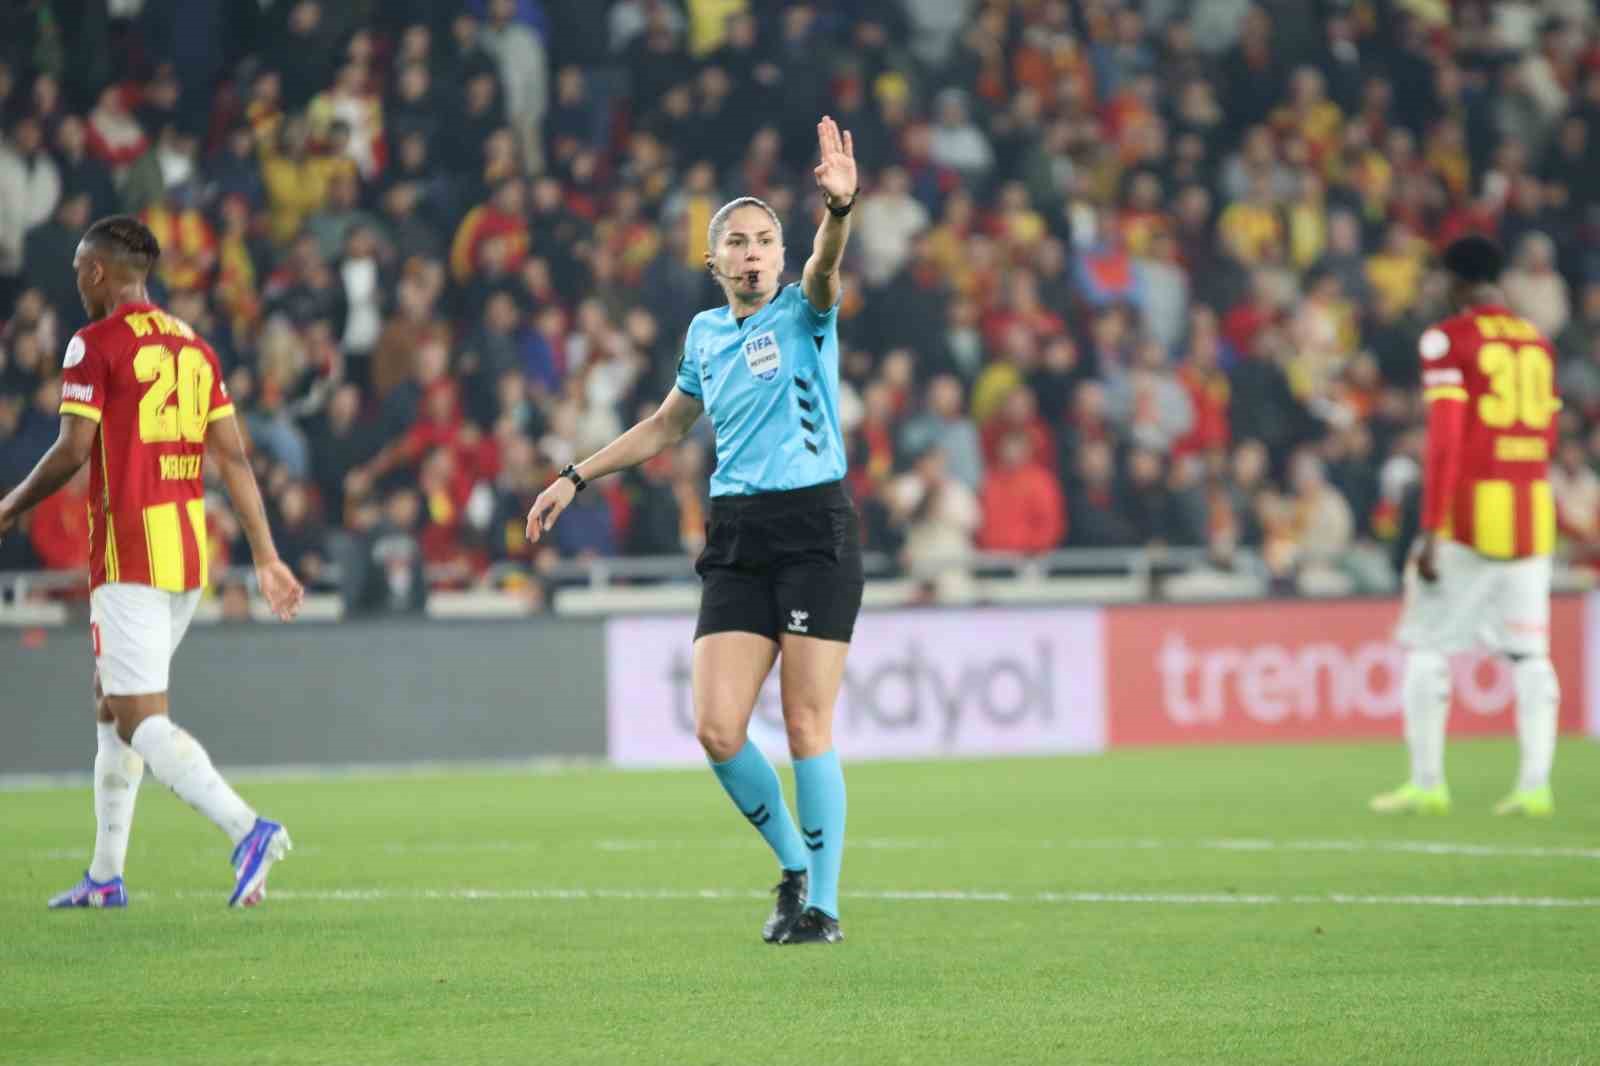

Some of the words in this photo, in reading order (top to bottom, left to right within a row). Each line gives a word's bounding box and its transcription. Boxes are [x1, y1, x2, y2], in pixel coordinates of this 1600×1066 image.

[745, 335, 773, 355] FIFA
[1478, 341, 1553, 429] 30
[133, 345, 213, 444] 20
[1156, 632, 1518, 725] trendo
